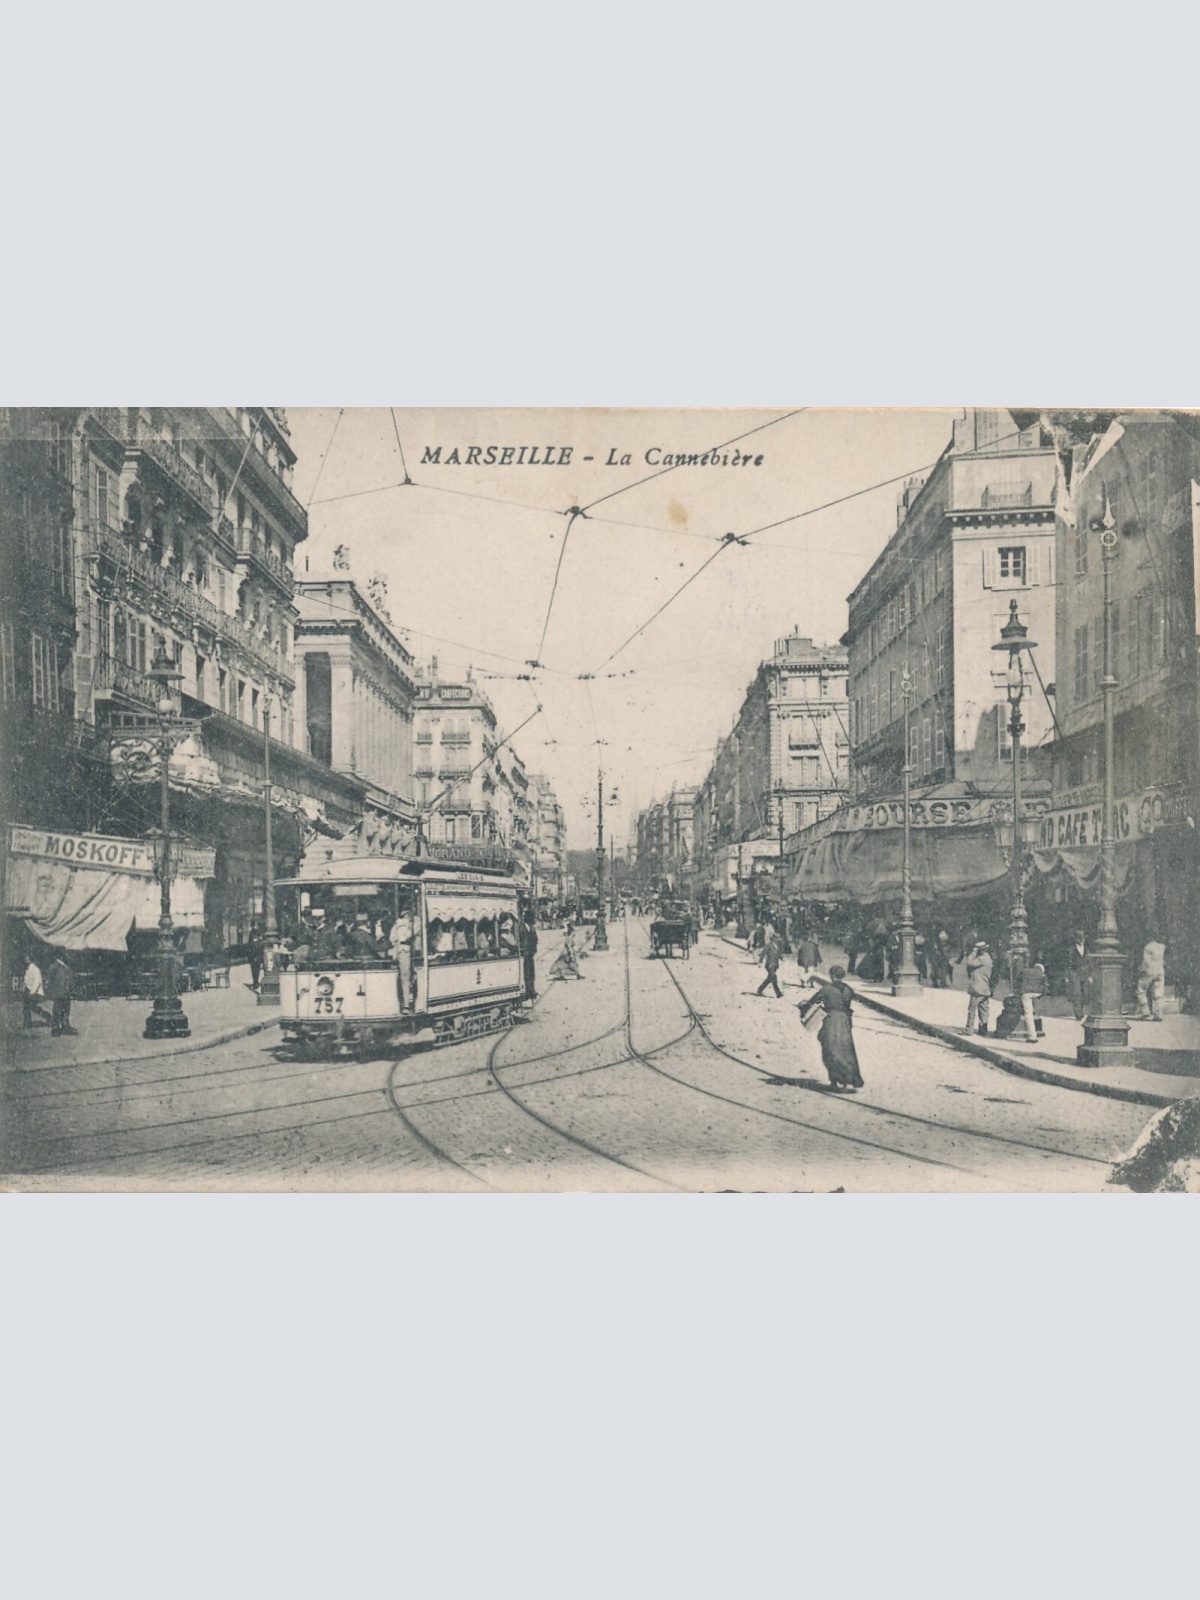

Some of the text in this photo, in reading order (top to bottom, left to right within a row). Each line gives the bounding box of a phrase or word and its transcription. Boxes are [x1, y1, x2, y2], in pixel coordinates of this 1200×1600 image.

[1058, 812, 1090, 846] CAFE
[44, 836, 146, 866] MOSKOFF
[314, 997, 344, 1014] 757
